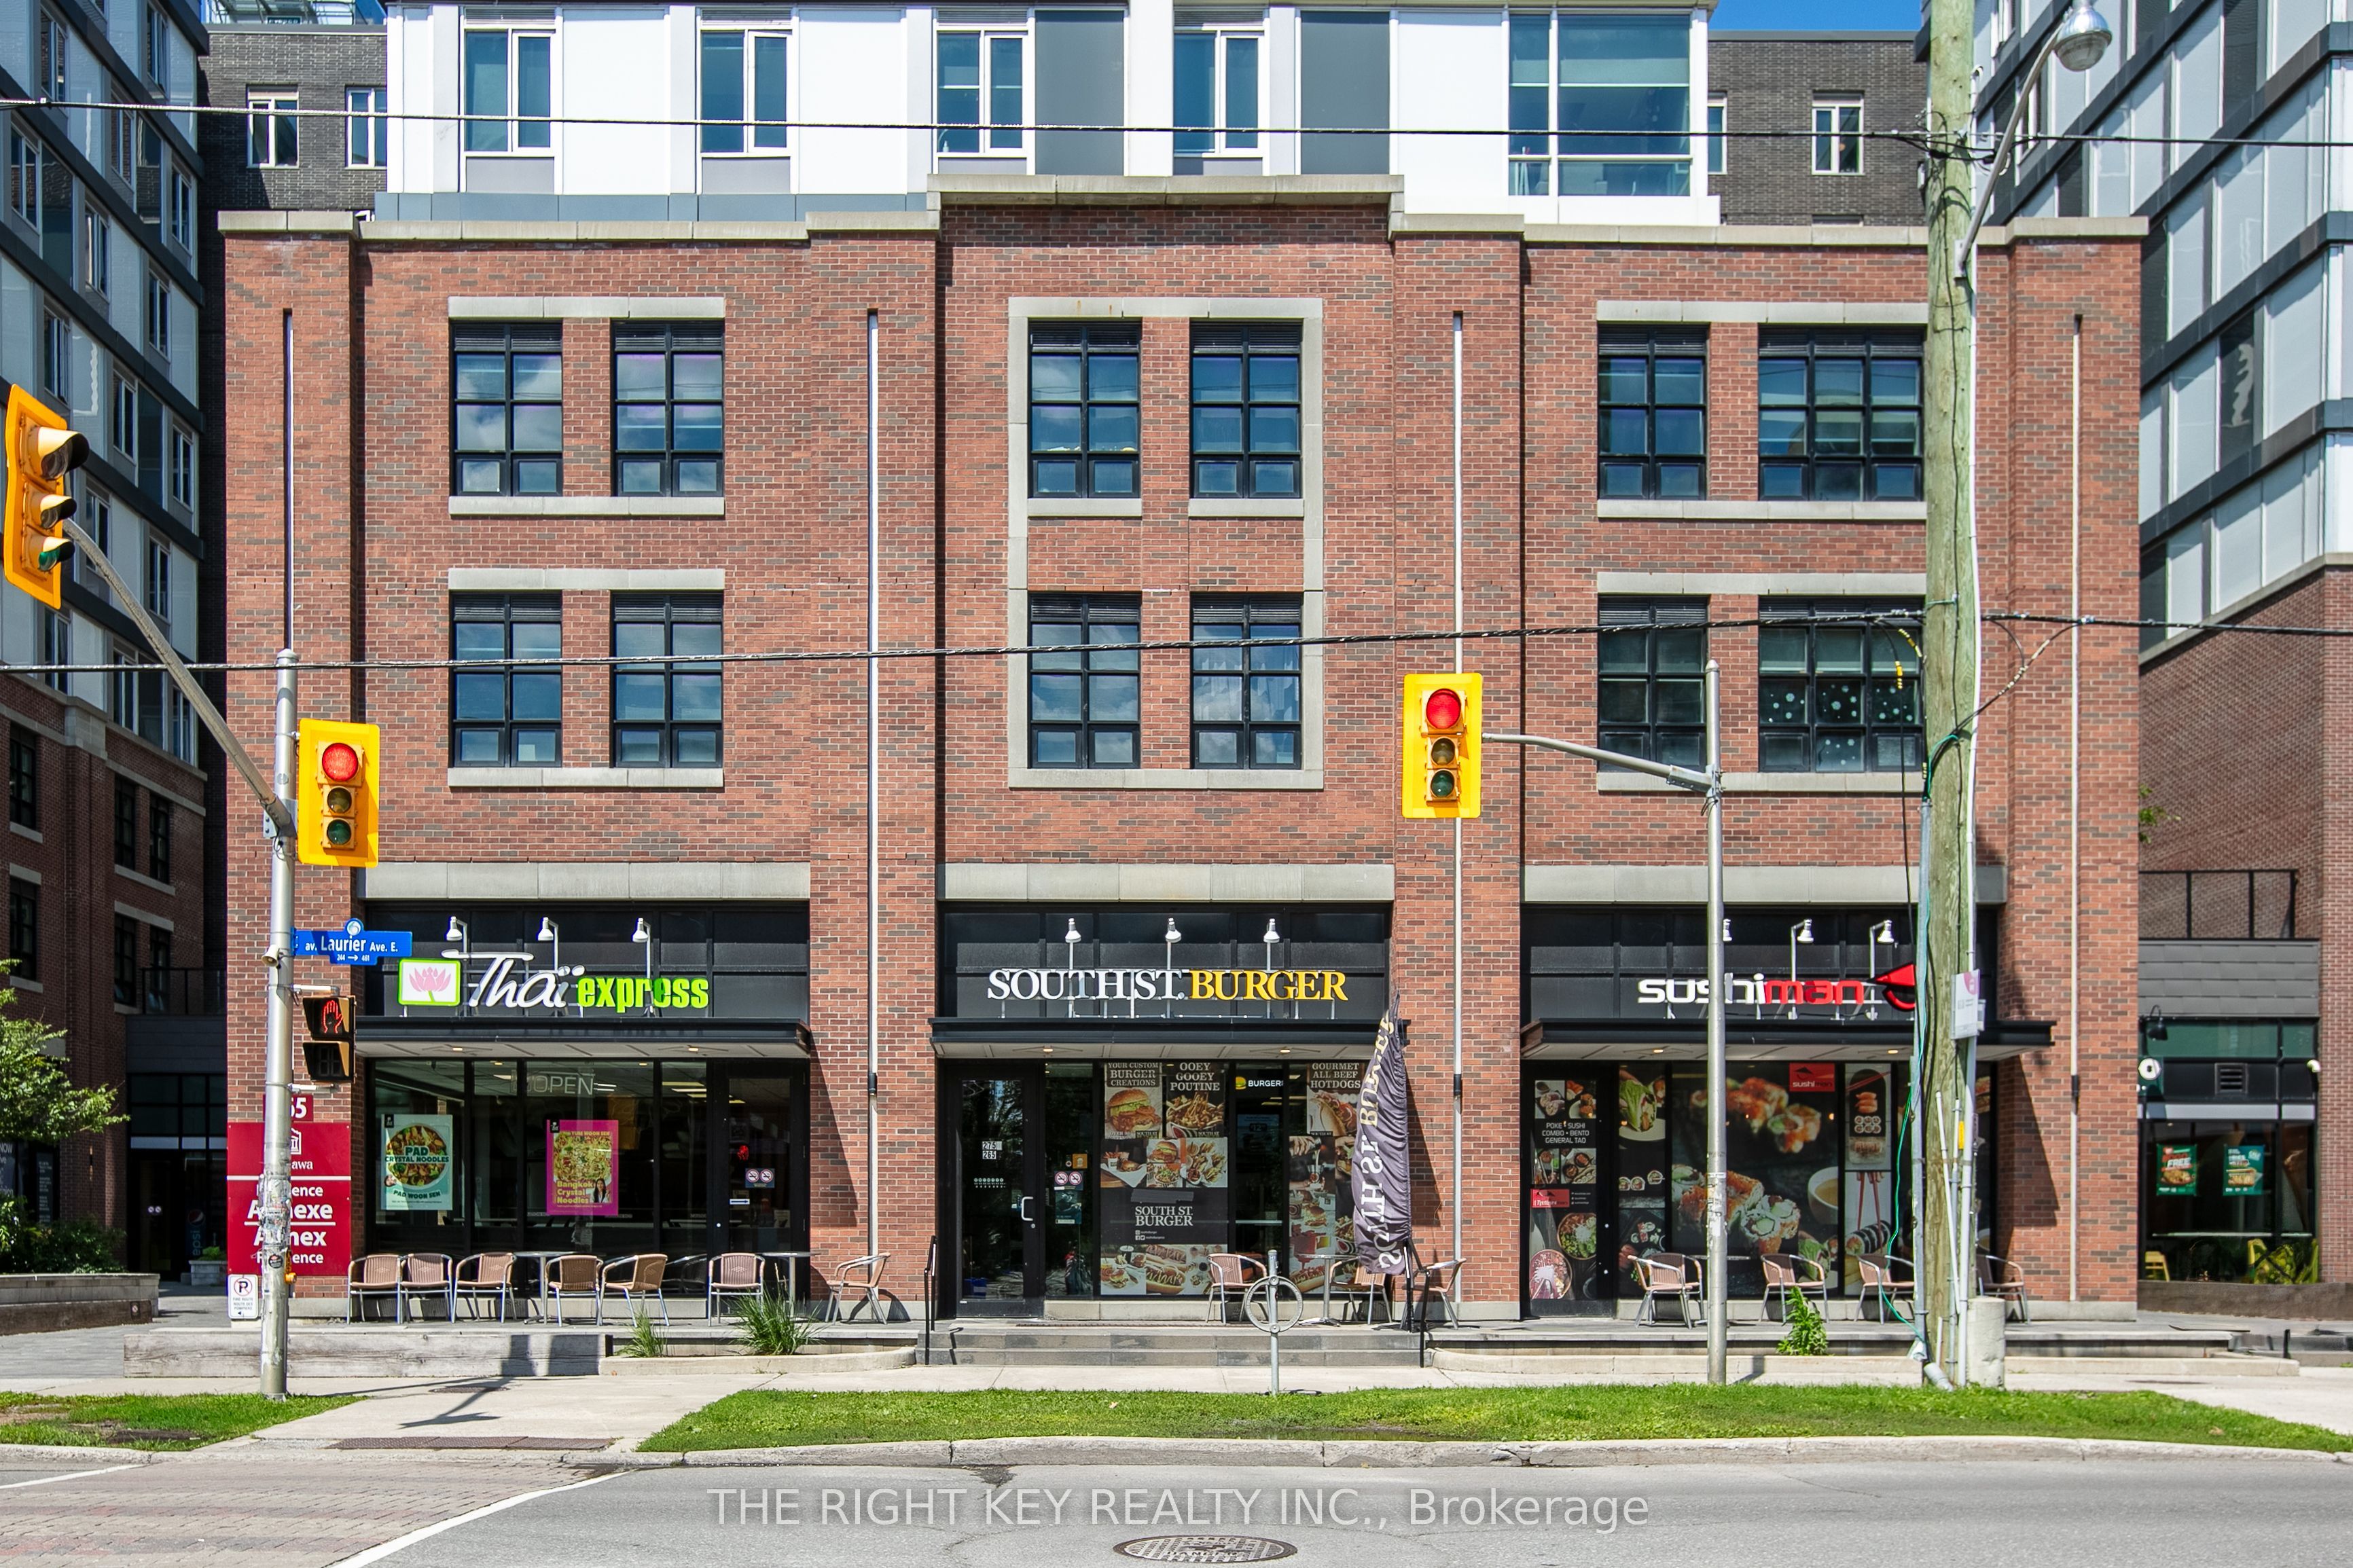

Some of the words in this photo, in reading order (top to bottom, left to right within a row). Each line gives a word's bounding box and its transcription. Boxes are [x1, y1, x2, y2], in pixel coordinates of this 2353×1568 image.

[306, 942, 317, 951] av.
[321, 935, 367, 952] Laurier
[370, 942, 388, 952] Ave.
[391, 942, 398, 952] E.
[442, 949, 586, 1008] Thaï
[577, 977, 709, 1013] express
[1190, 969, 1348, 1002] BURGER
[1179, 1062, 1210, 1071] OOEY
[1312, 1062, 1359, 1070] GOURMET
[1110, 1070, 1156, 1078] BURGER
[1175, 1072, 1215, 1081] GOOEY
[533, 1075, 594, 1095] OPEN
[1170, 1082, 1220, 1091] POUTINE
[1310, 1080, 1361, 1089] HOTDOGS
[983, 1142, 996, 1150] 275
[405, 1146, 429, 1156] PAD
[557, 1181, 593, 1189] Bangkok
[557, 1189, 585, 1197] Crystal
[247, 1200, 333, 1220] Aexe
[1135, 1205, 1175, 1216] SOUTH
[1178, 1205, 1193, 1216] ST.
[1135, 1215, 1193, 1226] BURGER
